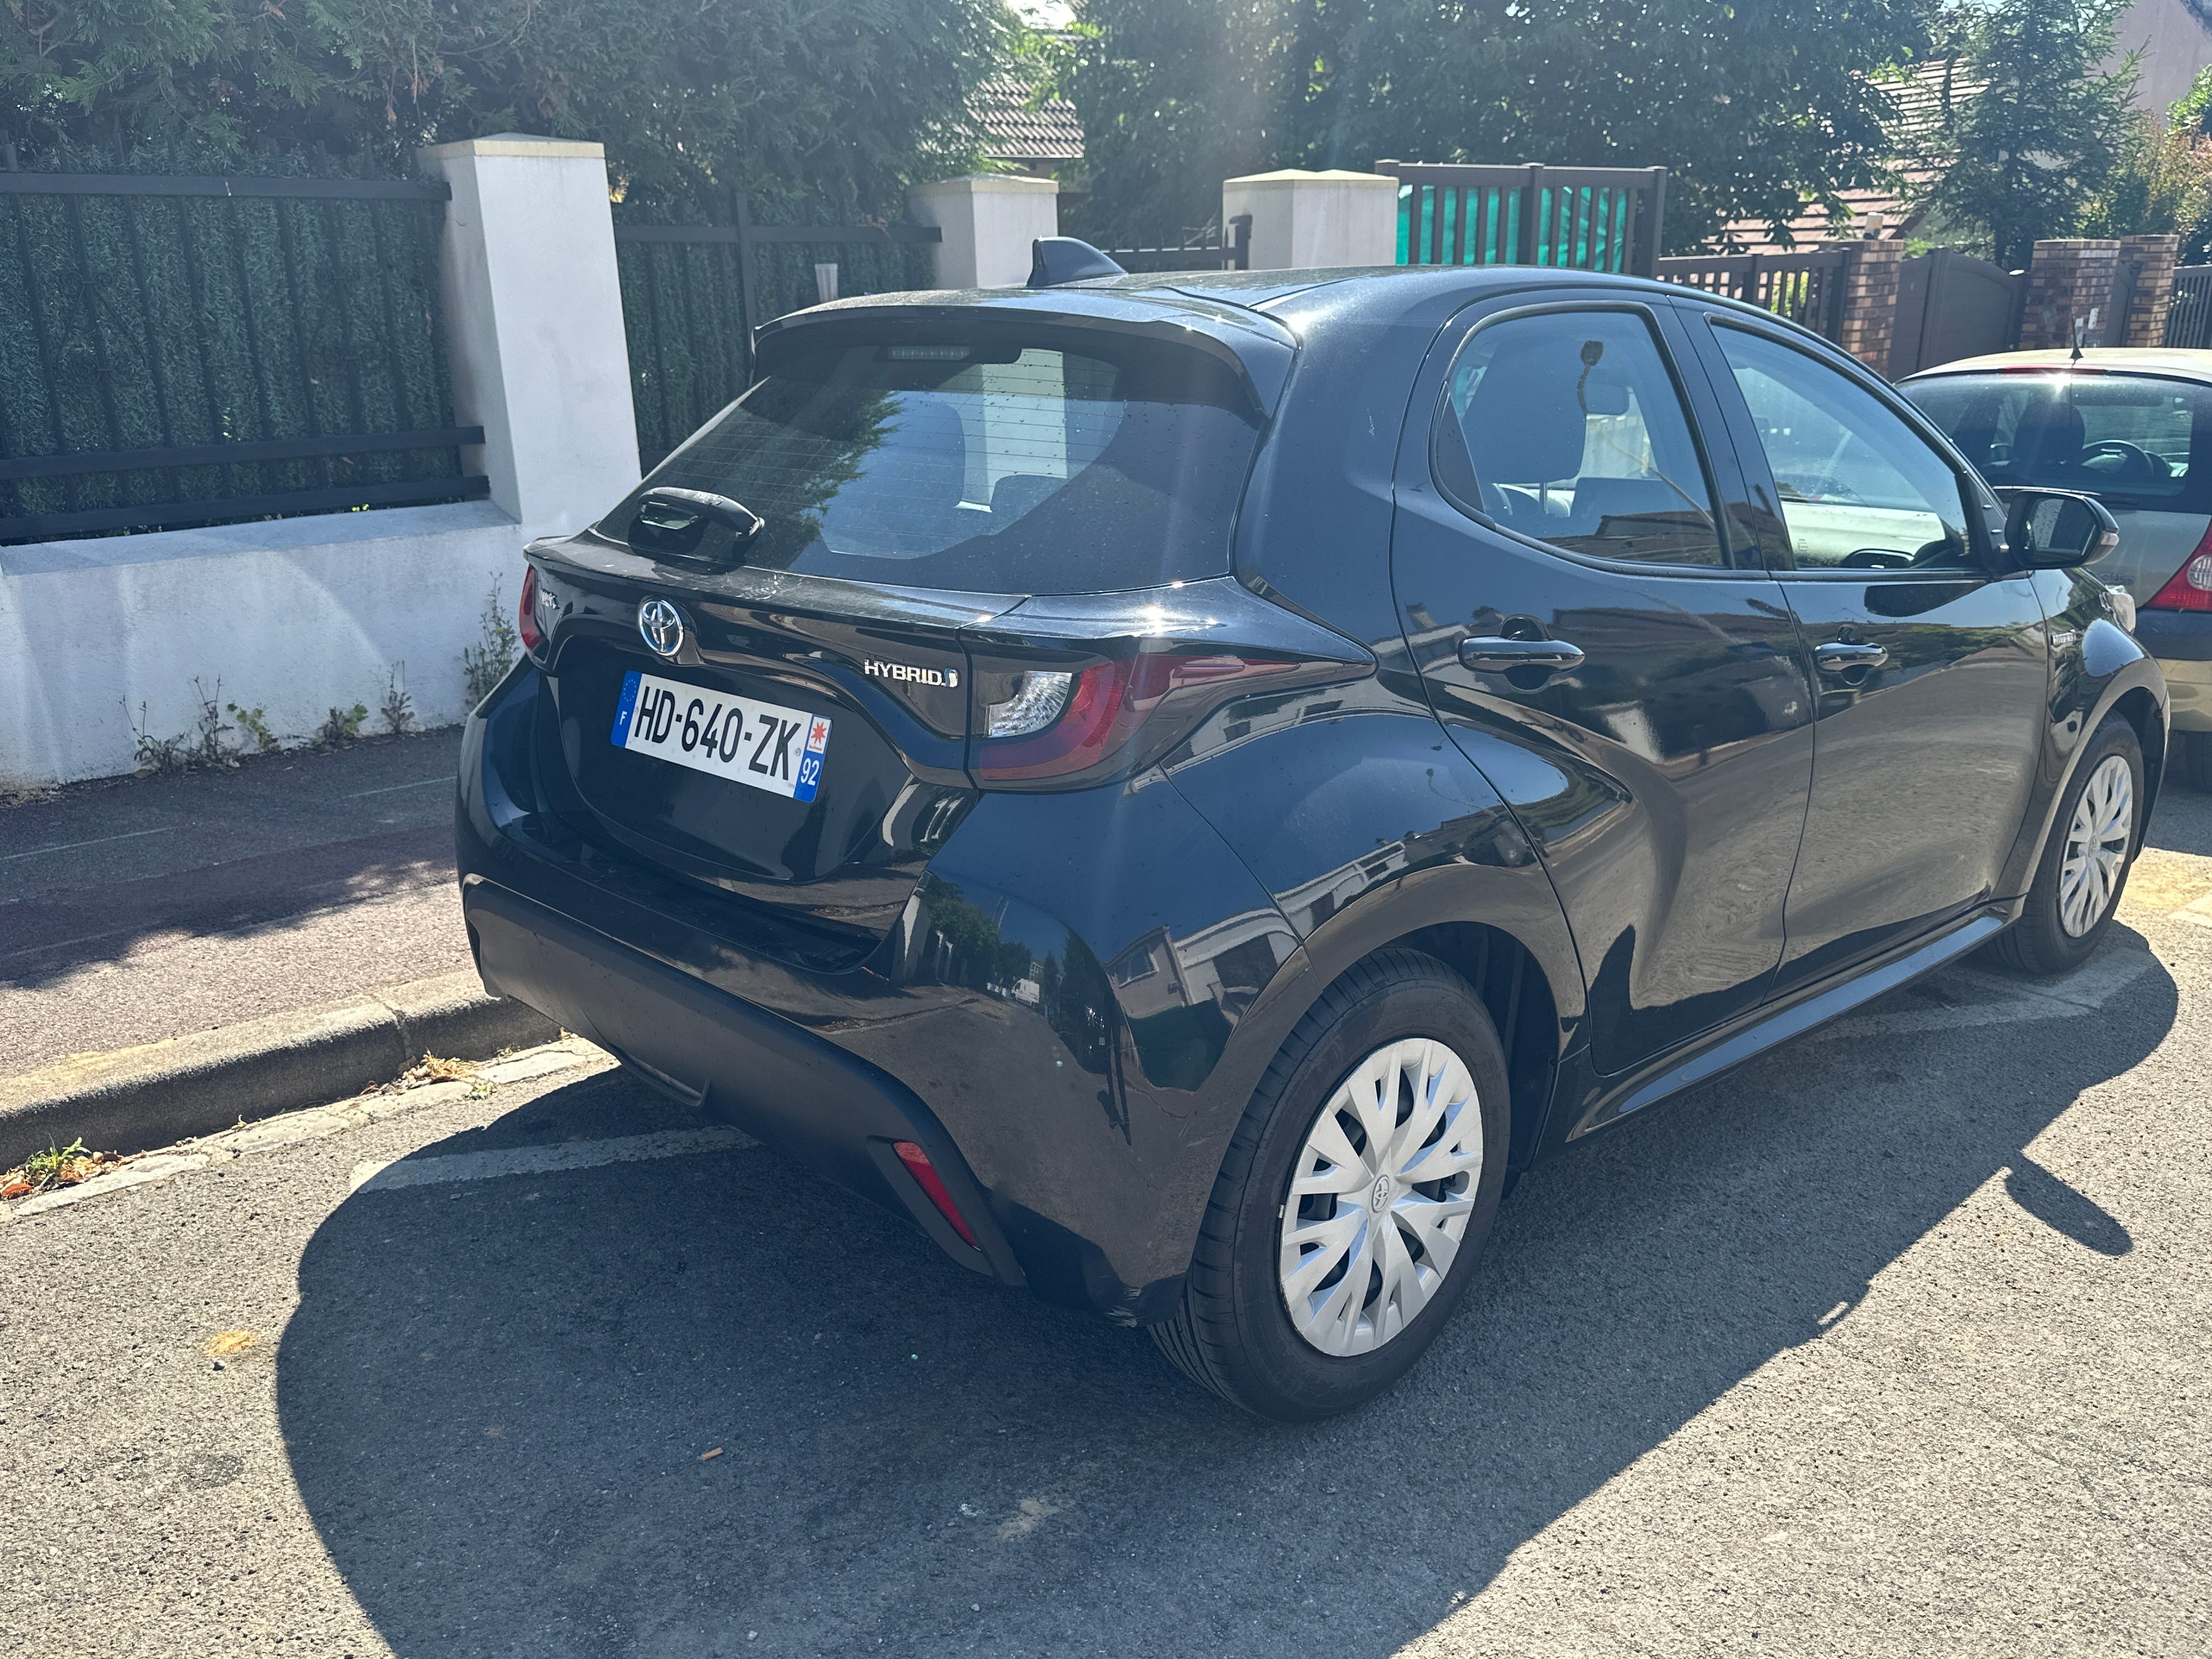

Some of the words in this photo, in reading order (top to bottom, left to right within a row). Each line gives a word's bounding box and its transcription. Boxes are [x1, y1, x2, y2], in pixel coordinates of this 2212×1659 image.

[864, 659, 943, 686] HYBRID
[619, 711, 628, 725] F
[634, 686, 802, 781] HD-640-ZK
[800, 758, 820, 786] 92
